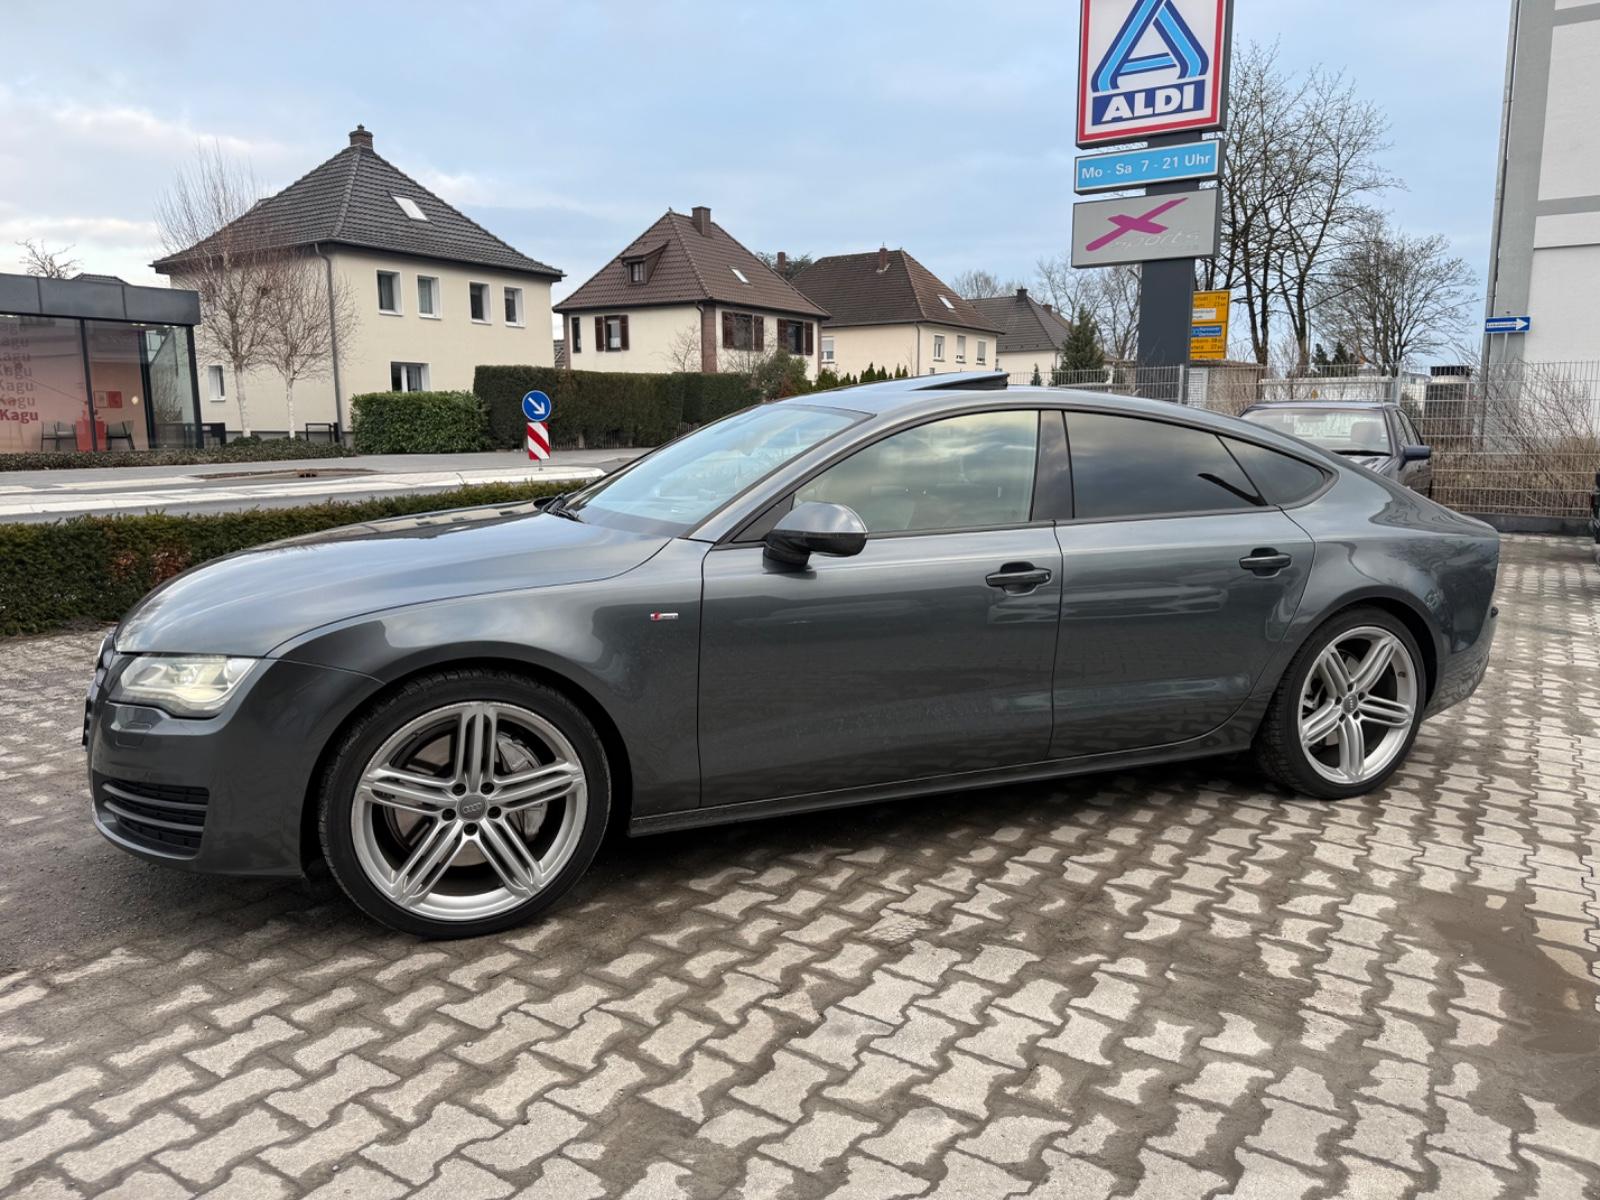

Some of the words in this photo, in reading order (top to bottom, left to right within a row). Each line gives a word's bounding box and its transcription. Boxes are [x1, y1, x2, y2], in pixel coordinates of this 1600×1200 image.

[1101, 83, 1196, 122] ALDI
[1081, 167, 1103, 179] Mo
[1115, 163, 1133, 175] Sa
[1141, 160, 1150, 172] 7
[1162, 157, 1179, 169] 21
[1184, 153, 1211, 166] Uhr
[0, 409, 38, 424] Kagu
